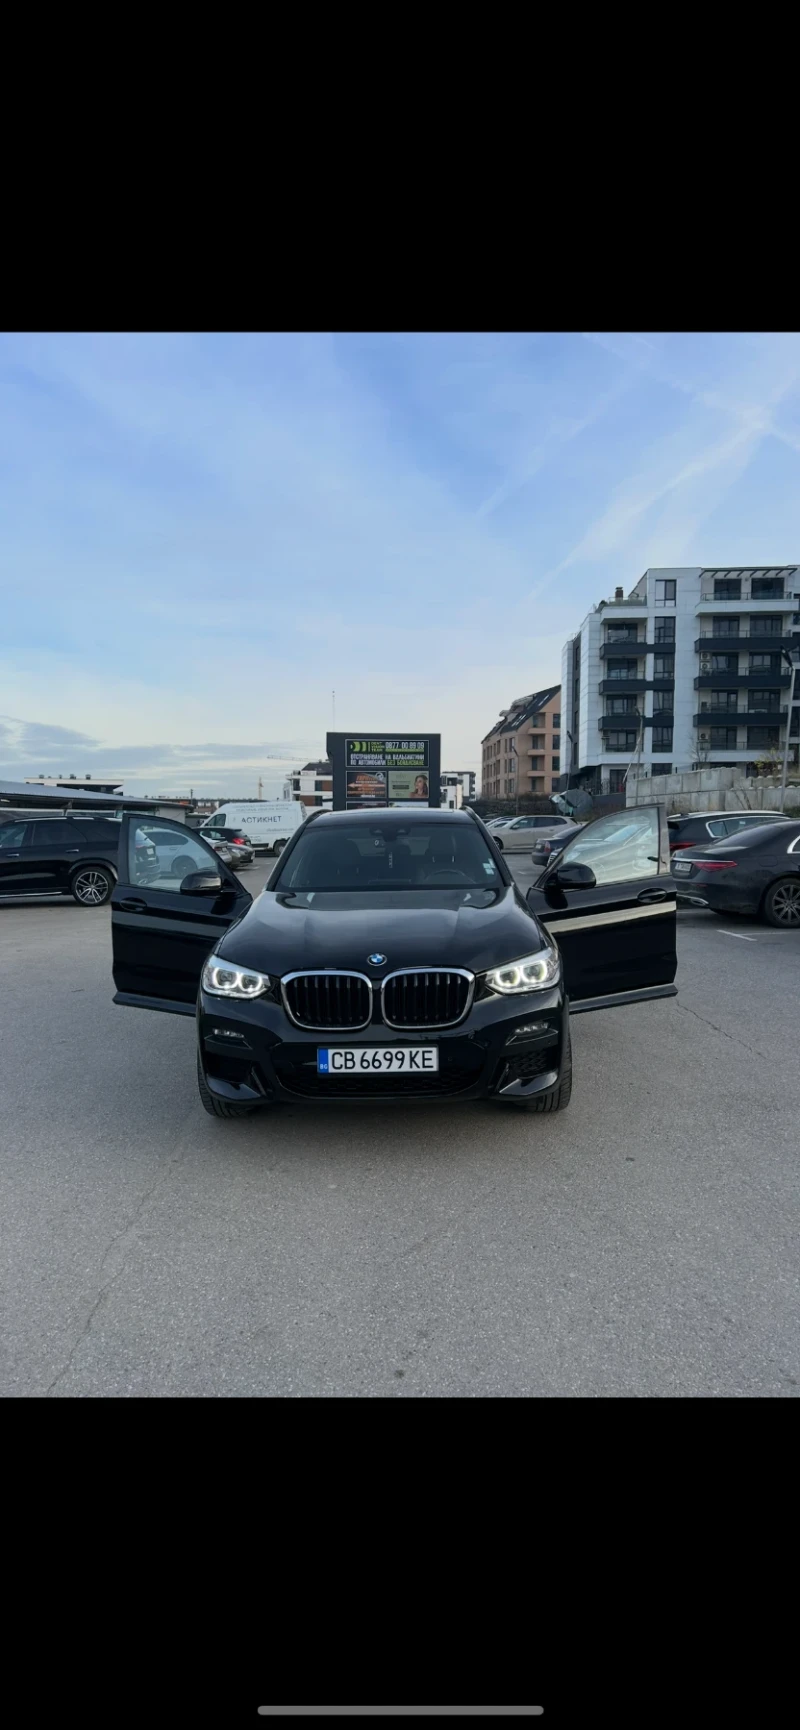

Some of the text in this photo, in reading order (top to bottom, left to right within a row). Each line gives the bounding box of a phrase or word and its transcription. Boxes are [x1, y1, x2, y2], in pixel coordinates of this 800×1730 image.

[331, 1050, 434, 1070] CB 6699 KE
